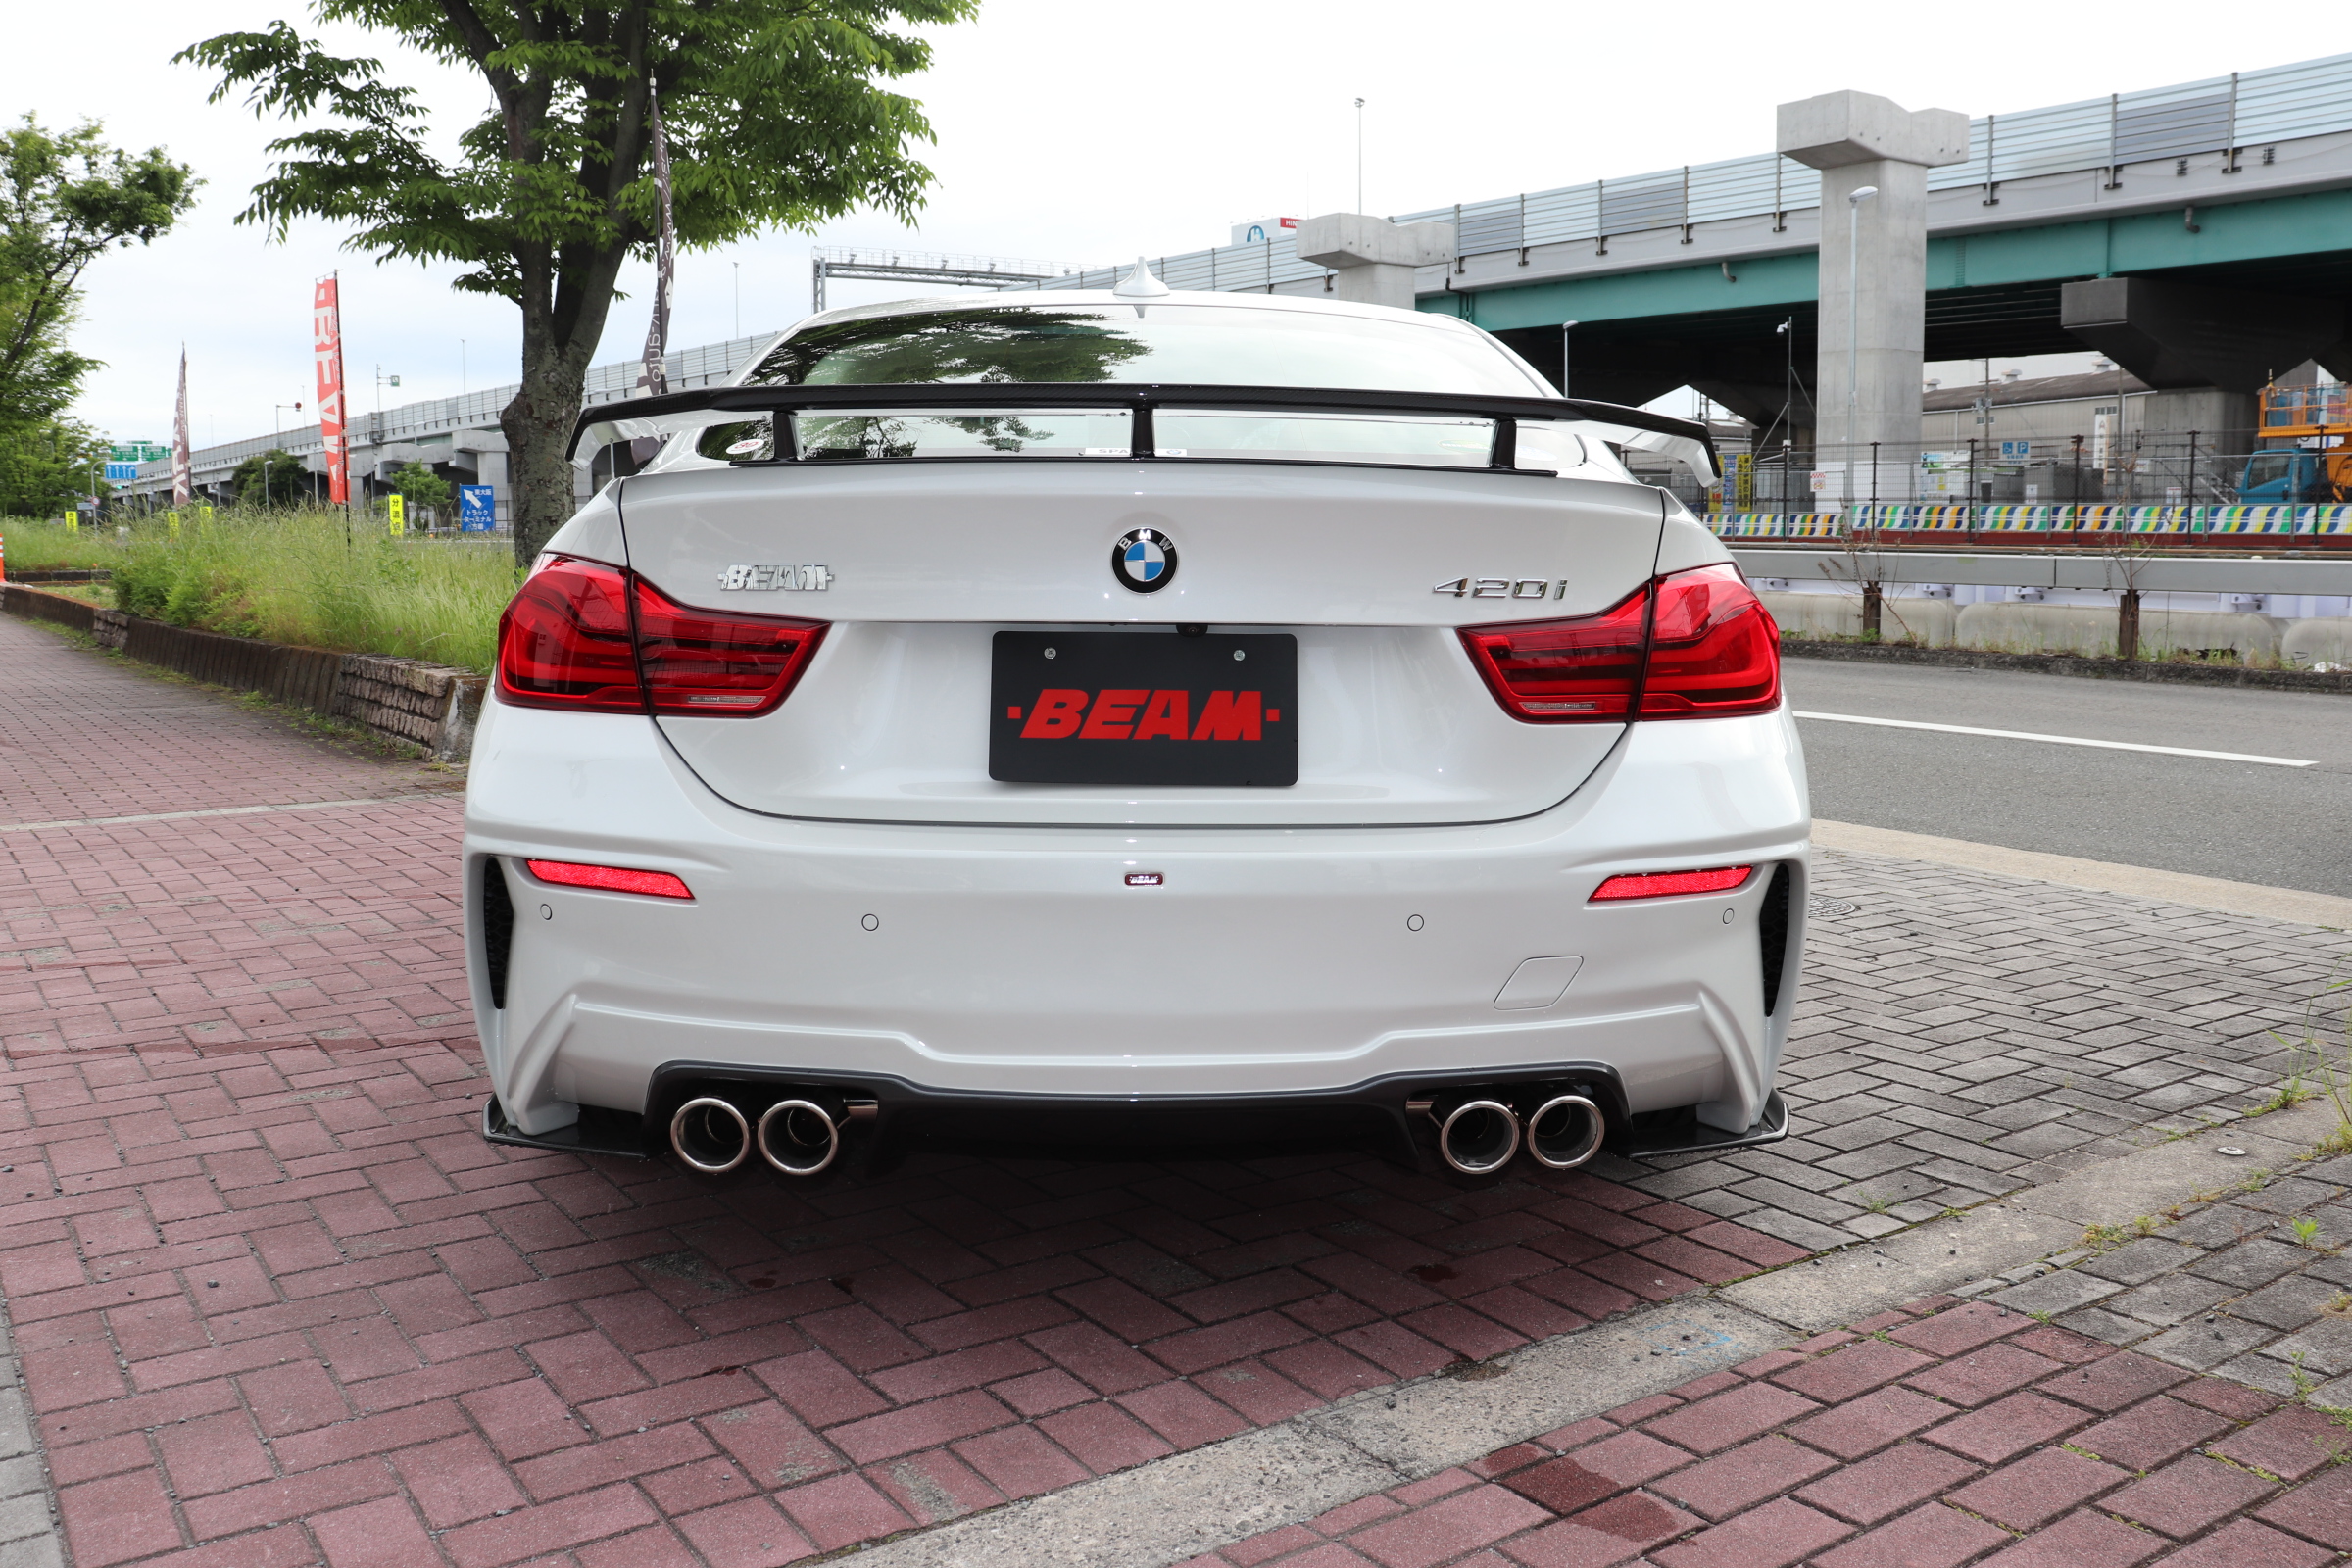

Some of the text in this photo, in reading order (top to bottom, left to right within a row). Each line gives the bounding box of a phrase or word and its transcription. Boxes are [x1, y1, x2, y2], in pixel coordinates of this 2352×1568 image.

[1118, 529, 1173, 551] BMW
[720, 564, 828, 591] BEAM
[1432, 577, 1568, 599] 420i
[1019, 688, 1262, 741] BEAM
